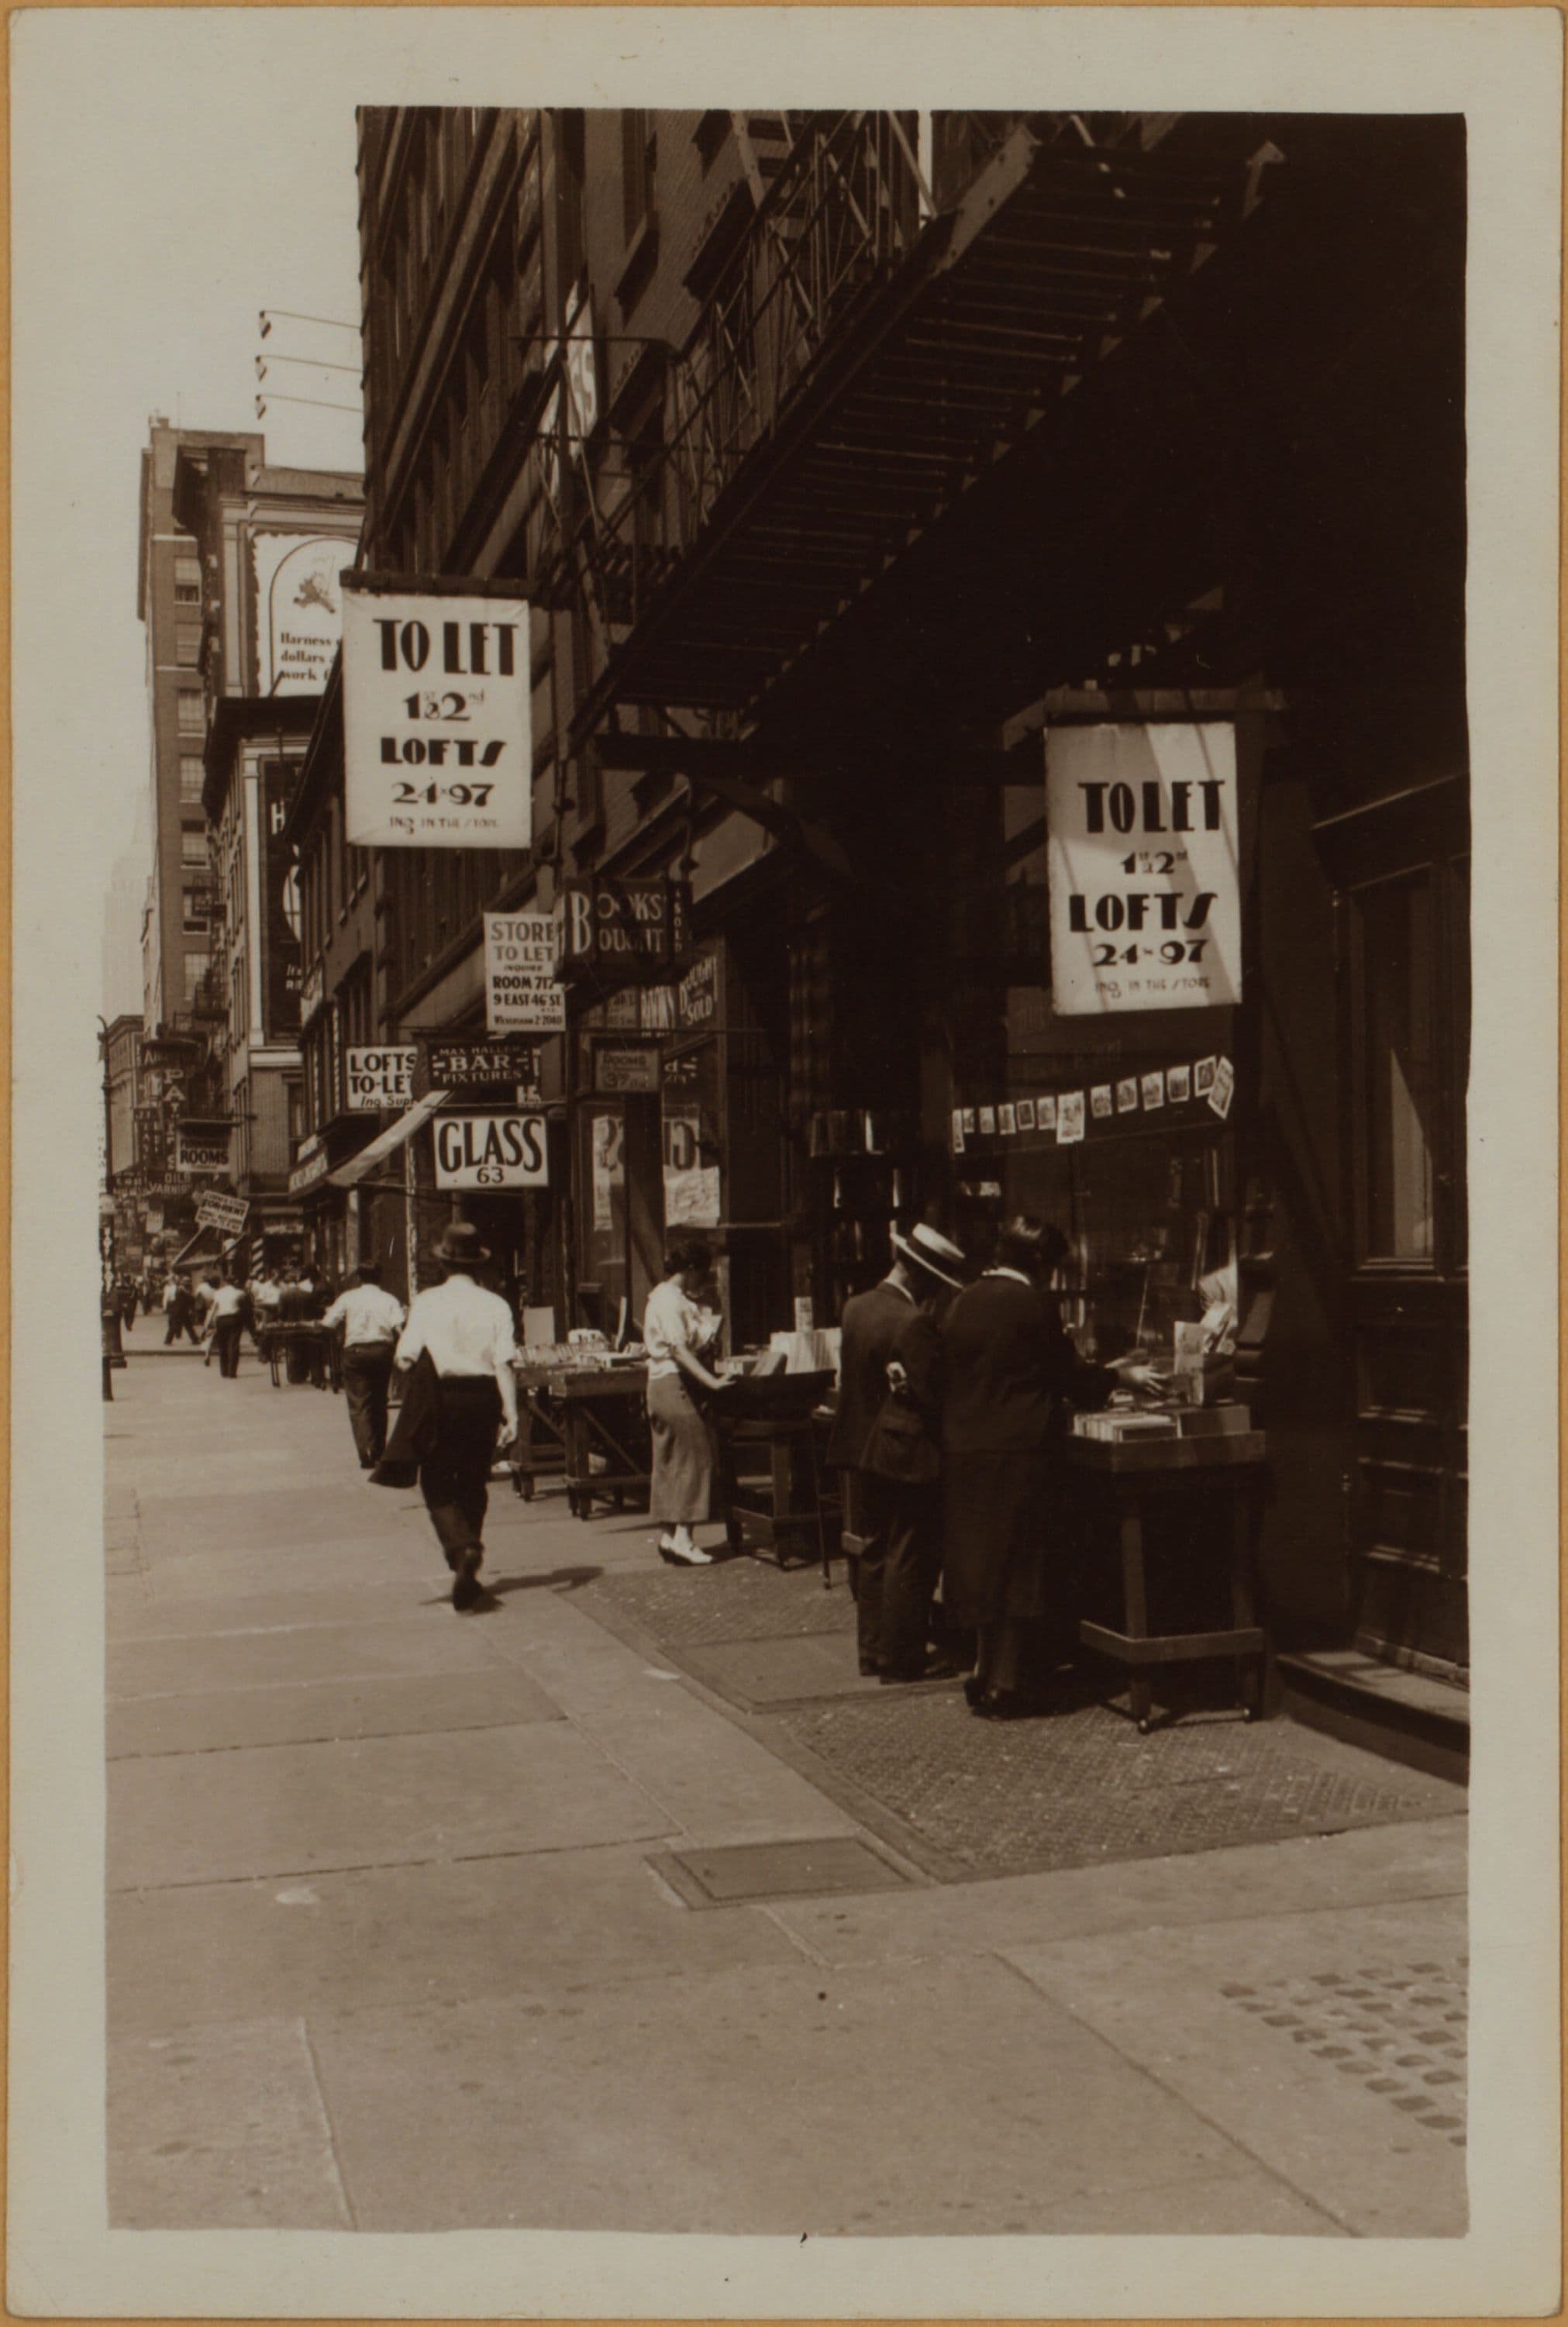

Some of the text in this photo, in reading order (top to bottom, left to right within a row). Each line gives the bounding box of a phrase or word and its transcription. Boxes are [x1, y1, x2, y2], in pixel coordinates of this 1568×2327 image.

[281, 632, 331, 646] Harness
[373, 619, 519, 676] TO LET
[281, 650, 325, 664] dollars
[281, 668, 317, 681] work
[381, 737, 506, 767] LOFTS
[1077, 780, 1225, 833] TO LET
[1069, 892, 1218, 932] LOFTS
[494, 946, 519, 961] TO
[492, 976, 532, 989] ROOM
[494, 994, 501, 1005] 9
[505, 994, 529, 1006] EAST
[687, 995, 713, 1026] SOLD
[350, 1053, 417, 1072] LOFTS
[450, 1055, 510, 1072] BAR
[349, 1075, 412, 1094] TO-LE
[442, 1070, 522, 1084] FIXTURES
[439, 1119, 543, 1173] GLASS
[181, 1150, 229, 1164] ROOMS
[477, 1167, 504, 1184] 63
